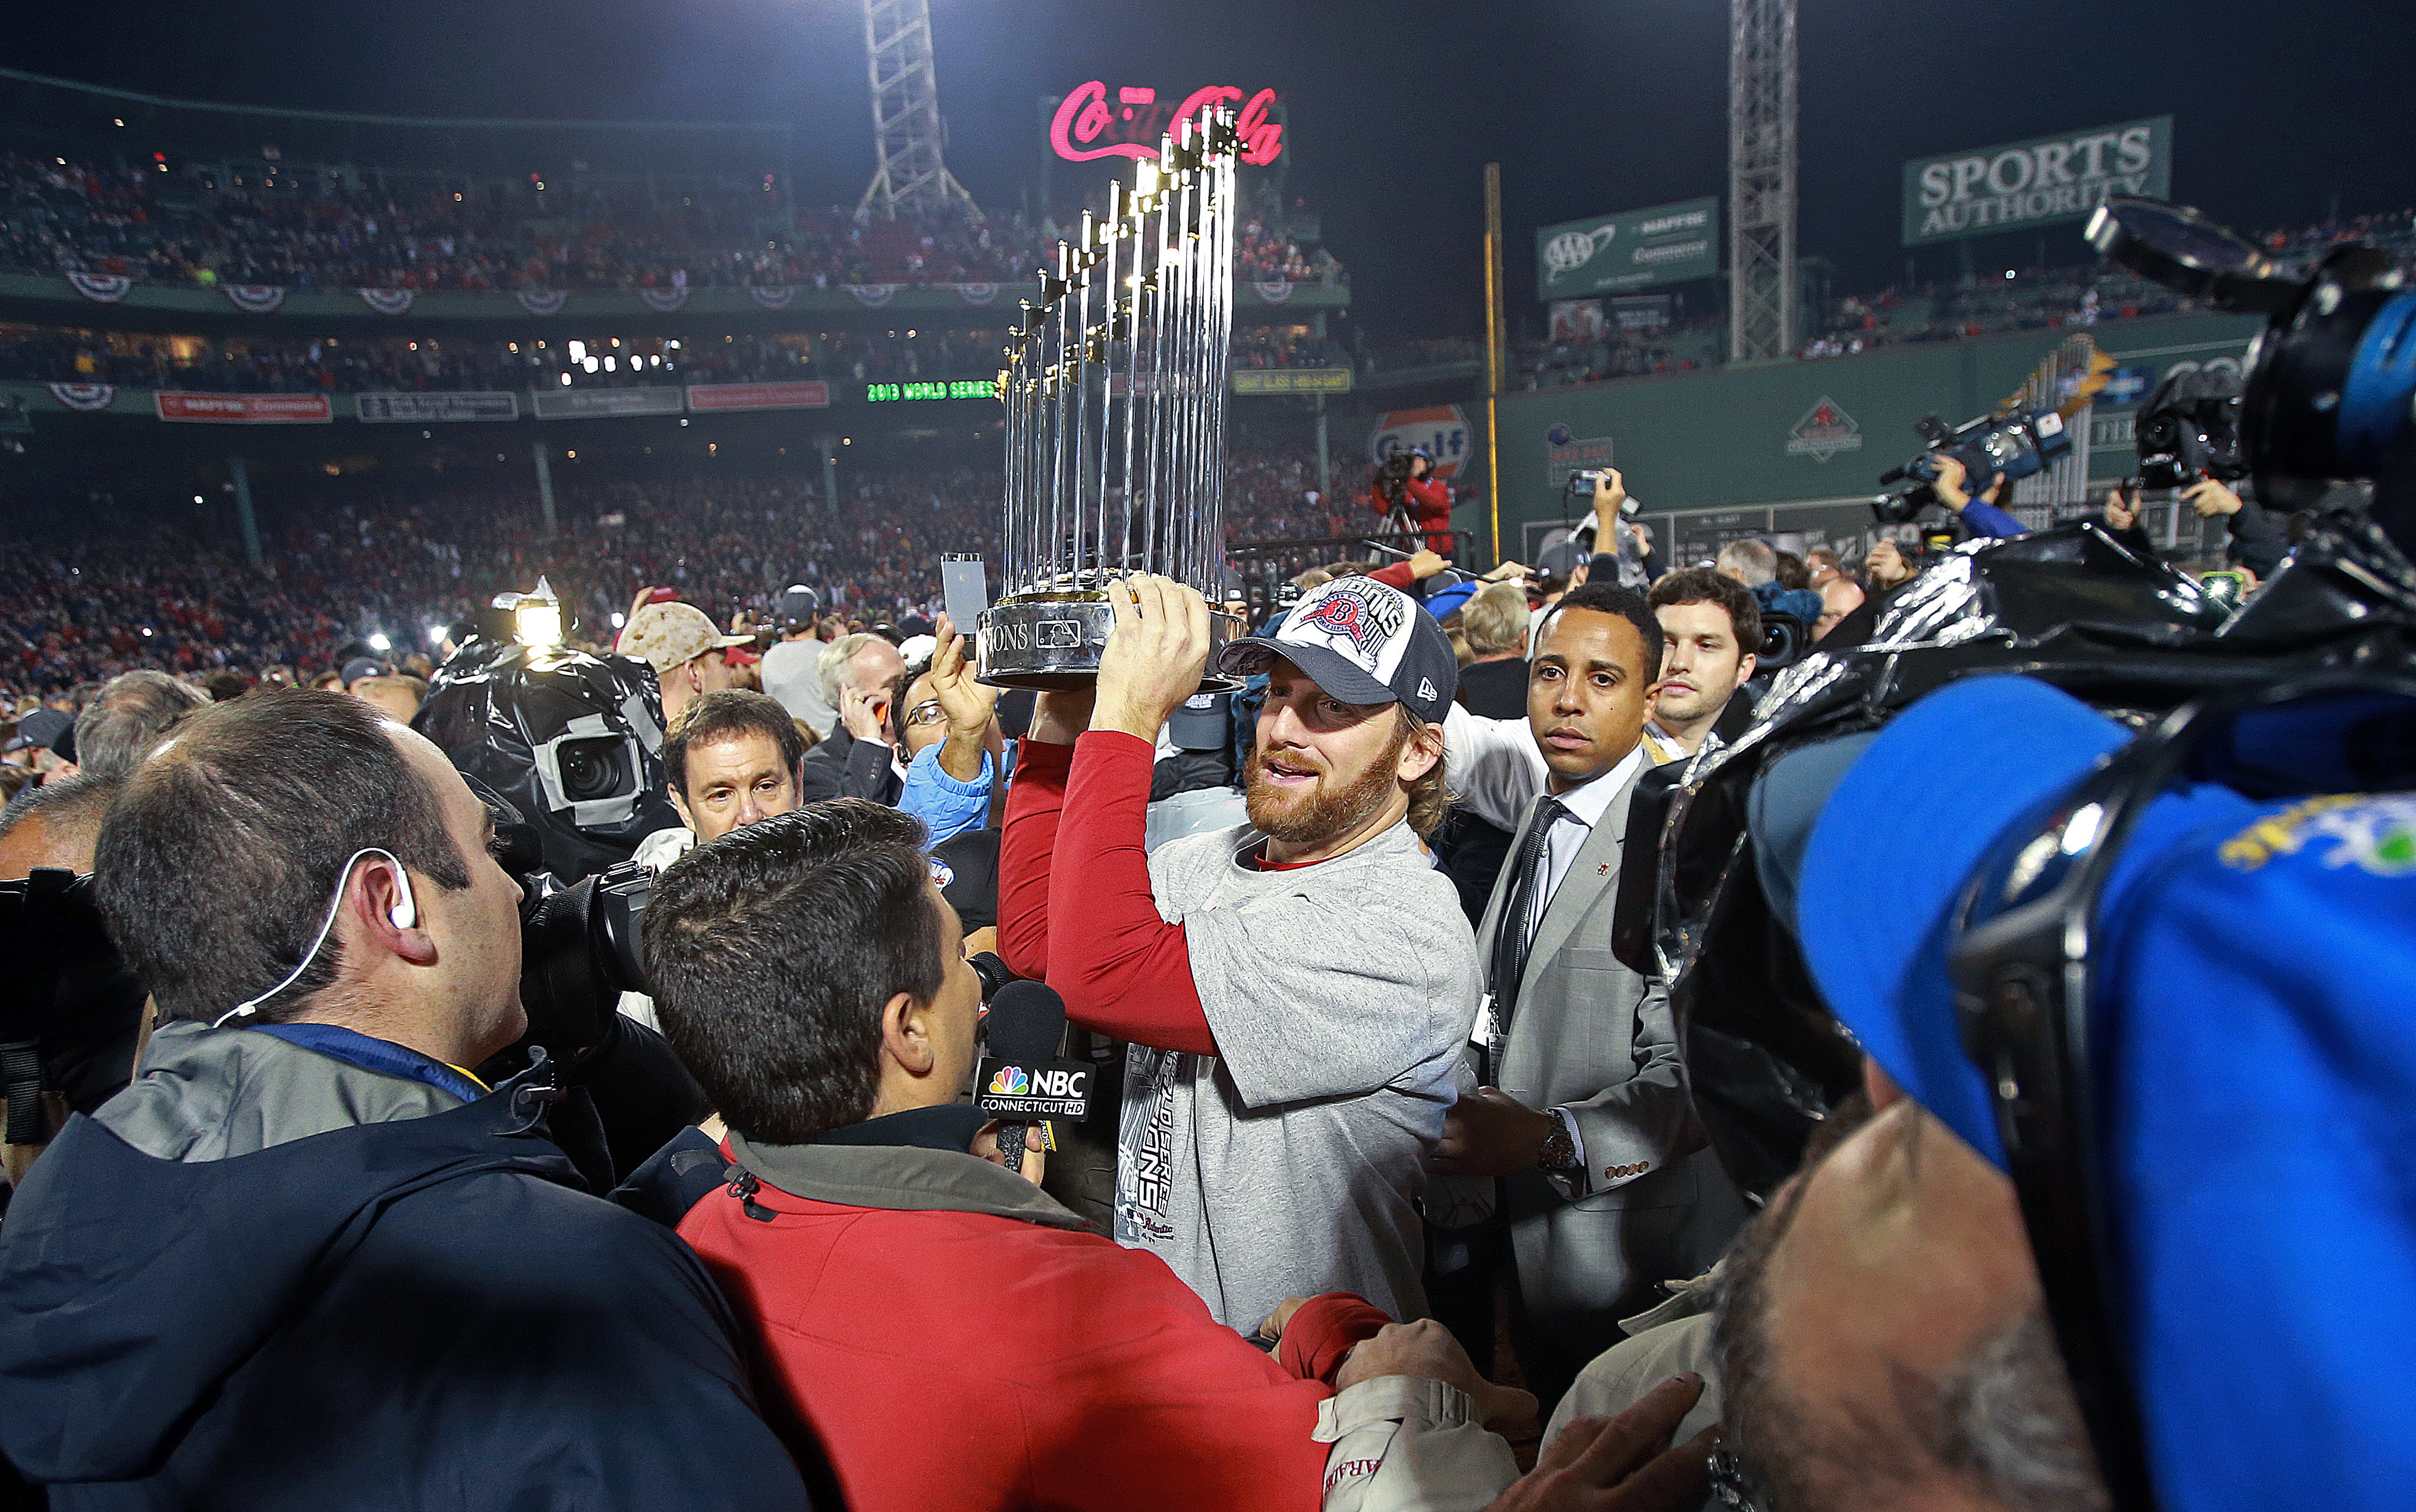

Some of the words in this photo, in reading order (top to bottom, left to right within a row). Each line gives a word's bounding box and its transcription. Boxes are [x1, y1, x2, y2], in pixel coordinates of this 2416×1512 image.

[1050, 80, 1282, 166] Coca-Cla
[1920, 127, 2151, 207] SPORTS
[1921, 172, 2148, 237] AUTHORITY
[867, 383, 899, 402] 2013
[903, 382, 946, 400] WORLD
[949, 380, 995, 399] SERIES
[1376, 428, 1463, 462] Glf
[981, 1099, 1064, 1114] CONNECTICUT
[1065, 1102, 1085, 1114] HD
[1031, 1069, 1086, 1098] NBC
[1159, 1130, 1172, 1218] SERIES
